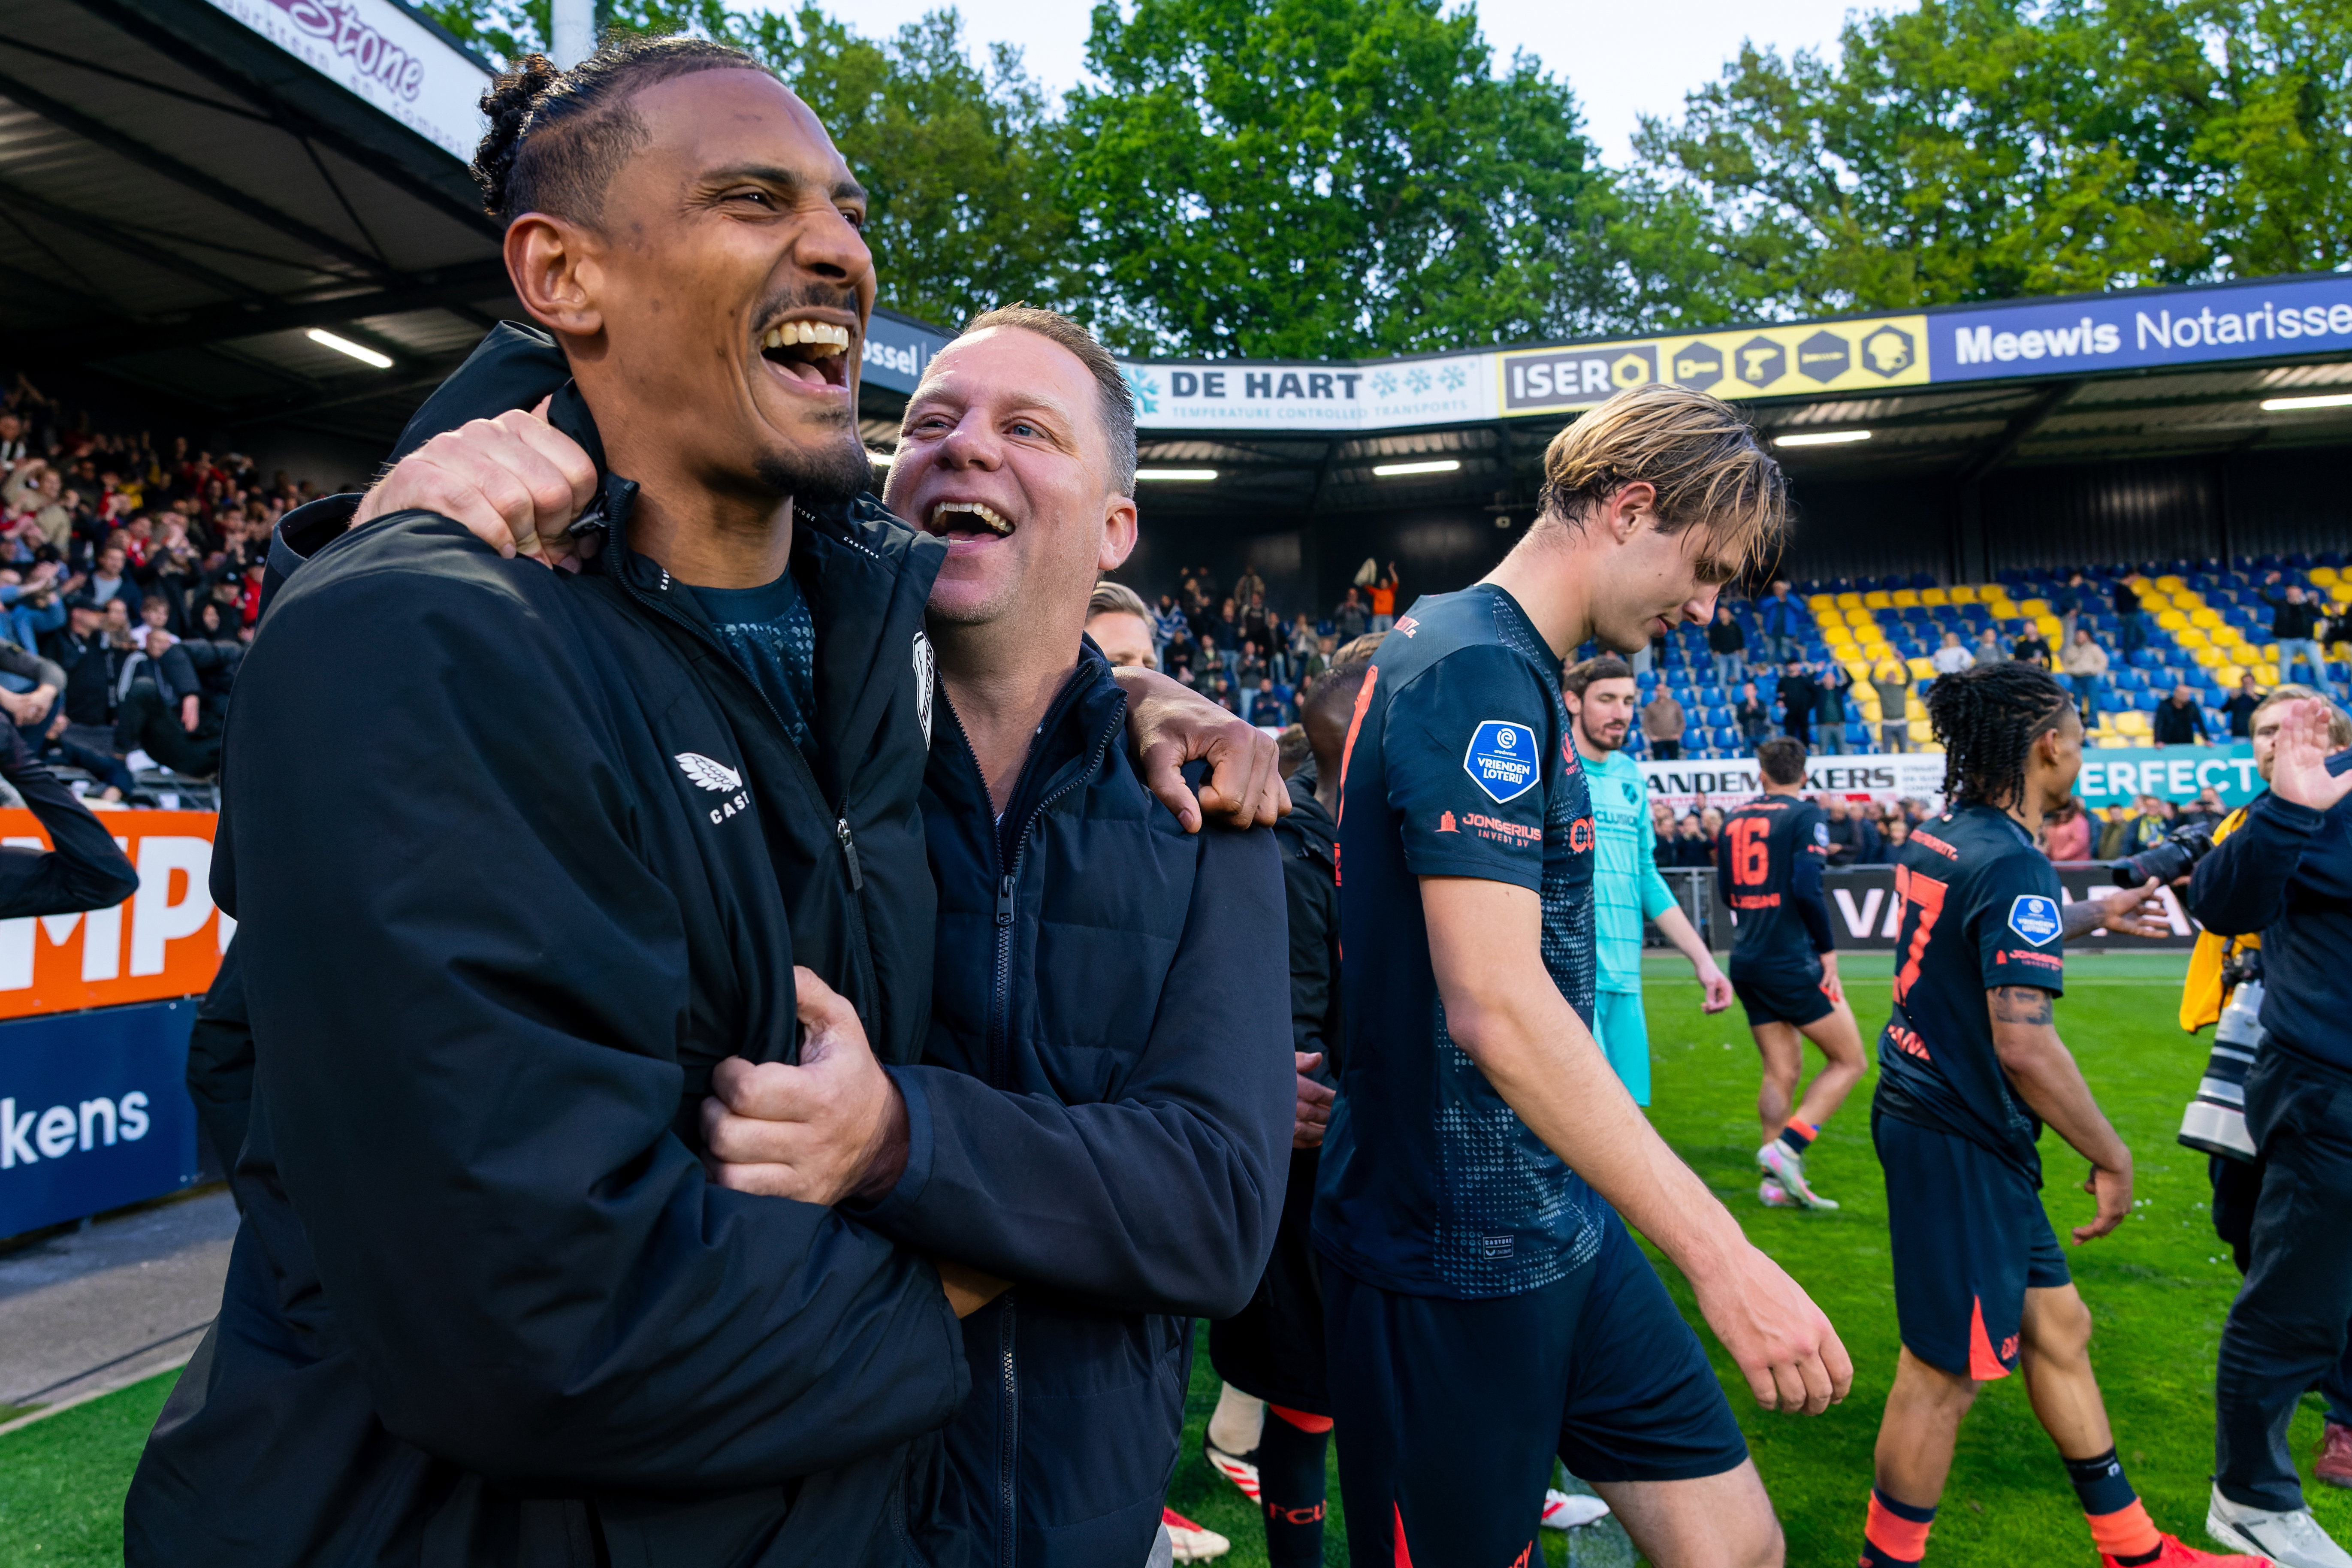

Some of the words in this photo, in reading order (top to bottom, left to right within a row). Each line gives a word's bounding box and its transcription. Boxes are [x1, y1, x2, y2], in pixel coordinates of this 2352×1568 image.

[288, 0, 424, 103] Stone
[1955, 317, 2121, 365] Meewis
[2135, 301, 2352, 350] Notarisse
[1172, 372, 1226, 398] DE
[1246, 373, 1362, 399] HART
[1513, 353, 1649, 399] ISERO
[1173, 406, 1271, 419] TEMPERATURE
[1277, 406, 1368, 419] CONTROLLED
[1374, 400, 1468, 417] TRANSPORTS
[1477, 757, 1530, 775] VRIENDEN
[1483, 767, 1523, 785] LOTERIJ
[2079, 758, 2258, 796] ERFECT
[1462, 813, 1542, 841] JONGERIUS
[1478, 829, 1513, 845] INVEST
[1517, 839, 1530, 848] BV
[1725, 817, 1770, 885] 16
[0, 1089, 150, 1169] kens
